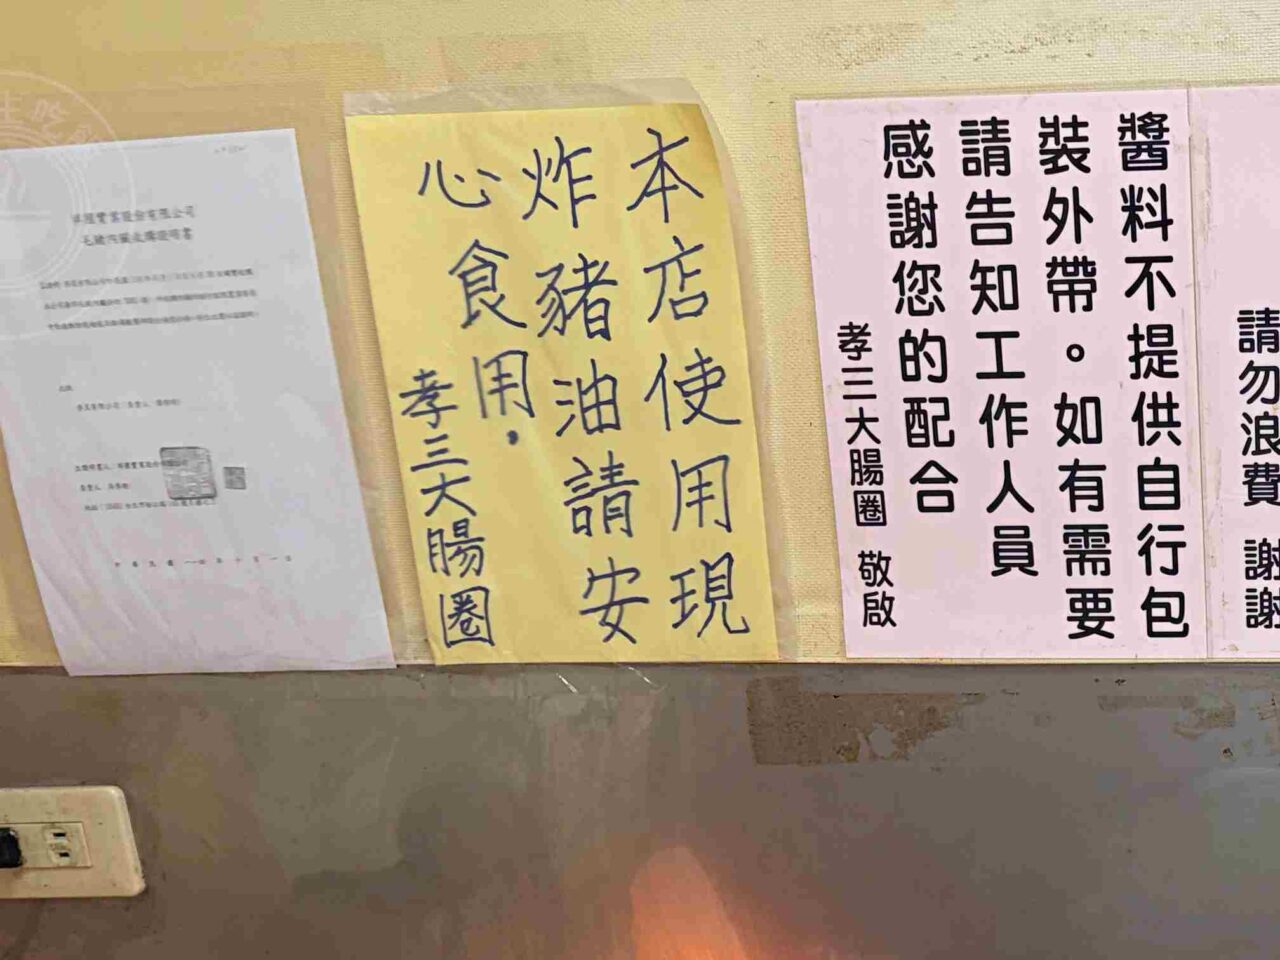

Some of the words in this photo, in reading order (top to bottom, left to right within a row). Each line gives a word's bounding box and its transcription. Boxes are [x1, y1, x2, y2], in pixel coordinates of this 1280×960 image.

[399, 367, 495, 648] 孝三大腸圈
[522, 135, 650, 644] 炸豬油請安
[627, 126, 750, 638] 本店使用現
[837, 321, 887, 527] 孝三大腸圈
[883, 118, 958, 514] 感謝您的配合
[958, 116, 1039, 578] 請告知工作人員
[1038, 114, 1115, 640] 裝外帶。如有需要
[1118, 111, 1189, 638] 醬料不提供自行包
[857, 549, 897, 628] 敬啟
